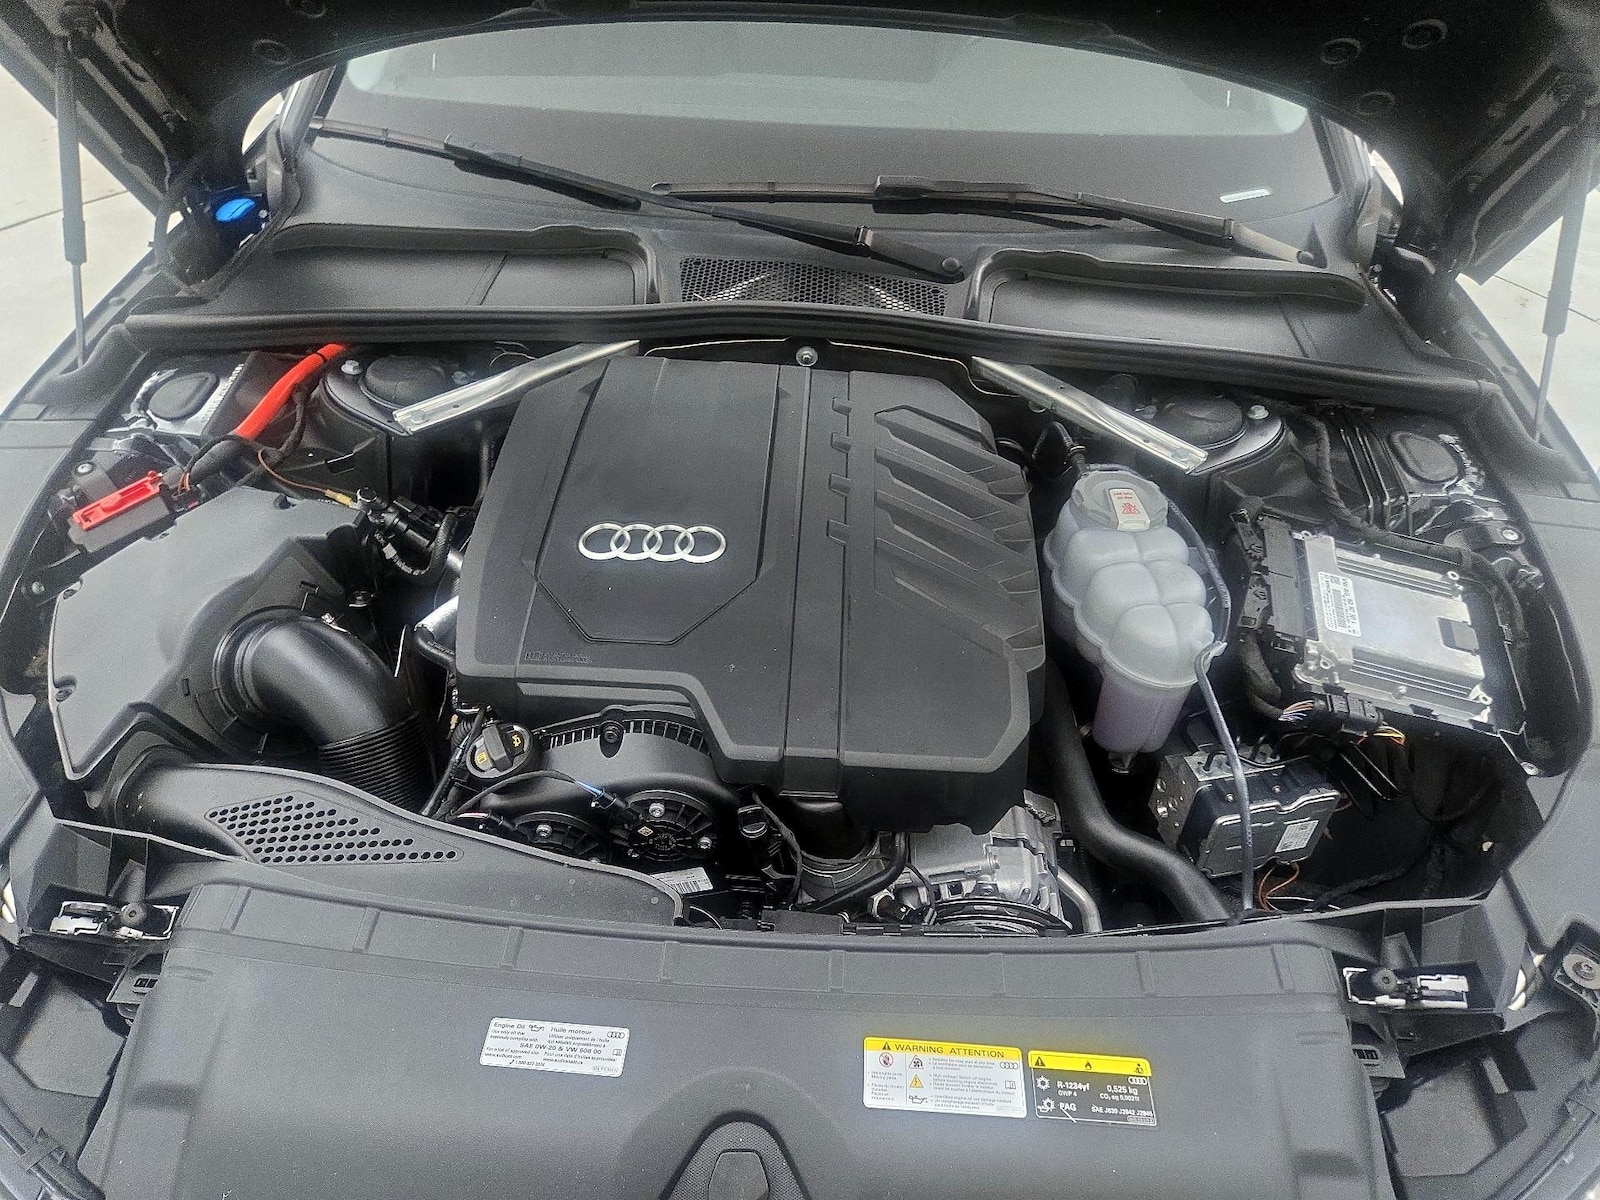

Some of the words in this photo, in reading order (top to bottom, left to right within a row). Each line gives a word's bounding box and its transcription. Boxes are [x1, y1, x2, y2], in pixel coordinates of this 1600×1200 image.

[894, 1044, 944, 1054] WARNING
[949, 1048, 1005, 1058] ATTENTION
[1057, 1080, 1090, 1092] R-1234yf
[1106, 1084, 1128, 1093] 0,525
[1128, 1086, 1138, 1095] kg
[1059, 1102, 1077, 1112] PAG
[1091, 1105, 1104, 1113] SAE
